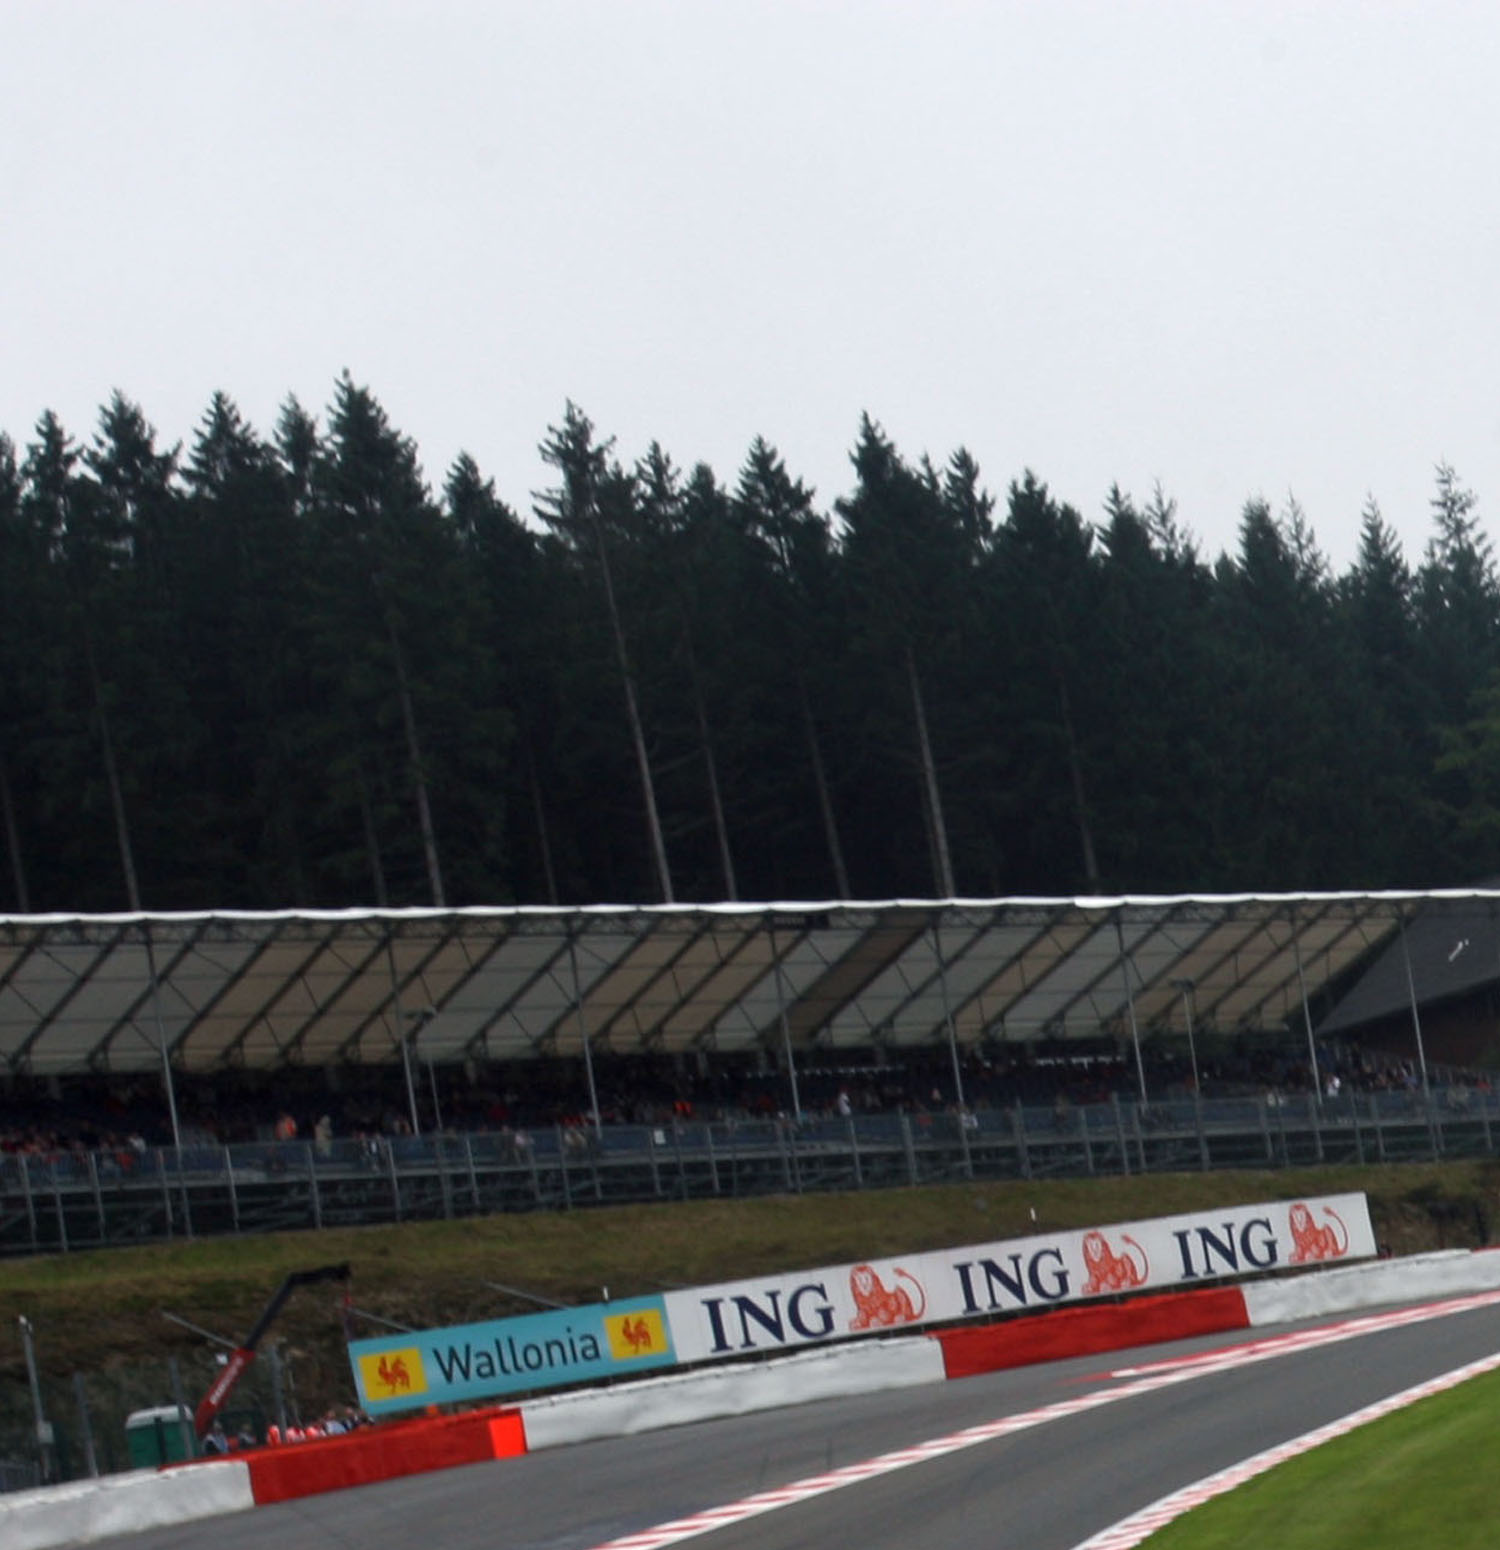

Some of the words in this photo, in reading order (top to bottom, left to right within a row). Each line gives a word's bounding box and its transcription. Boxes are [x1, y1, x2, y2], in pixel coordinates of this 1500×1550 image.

[952, 1247, 1071, 1315] ING
[1173, 1218, 1278, 1280] ING
[700, 1283, 836, 1353] ING
[432, 1325, 601, 1385] Wallonia
